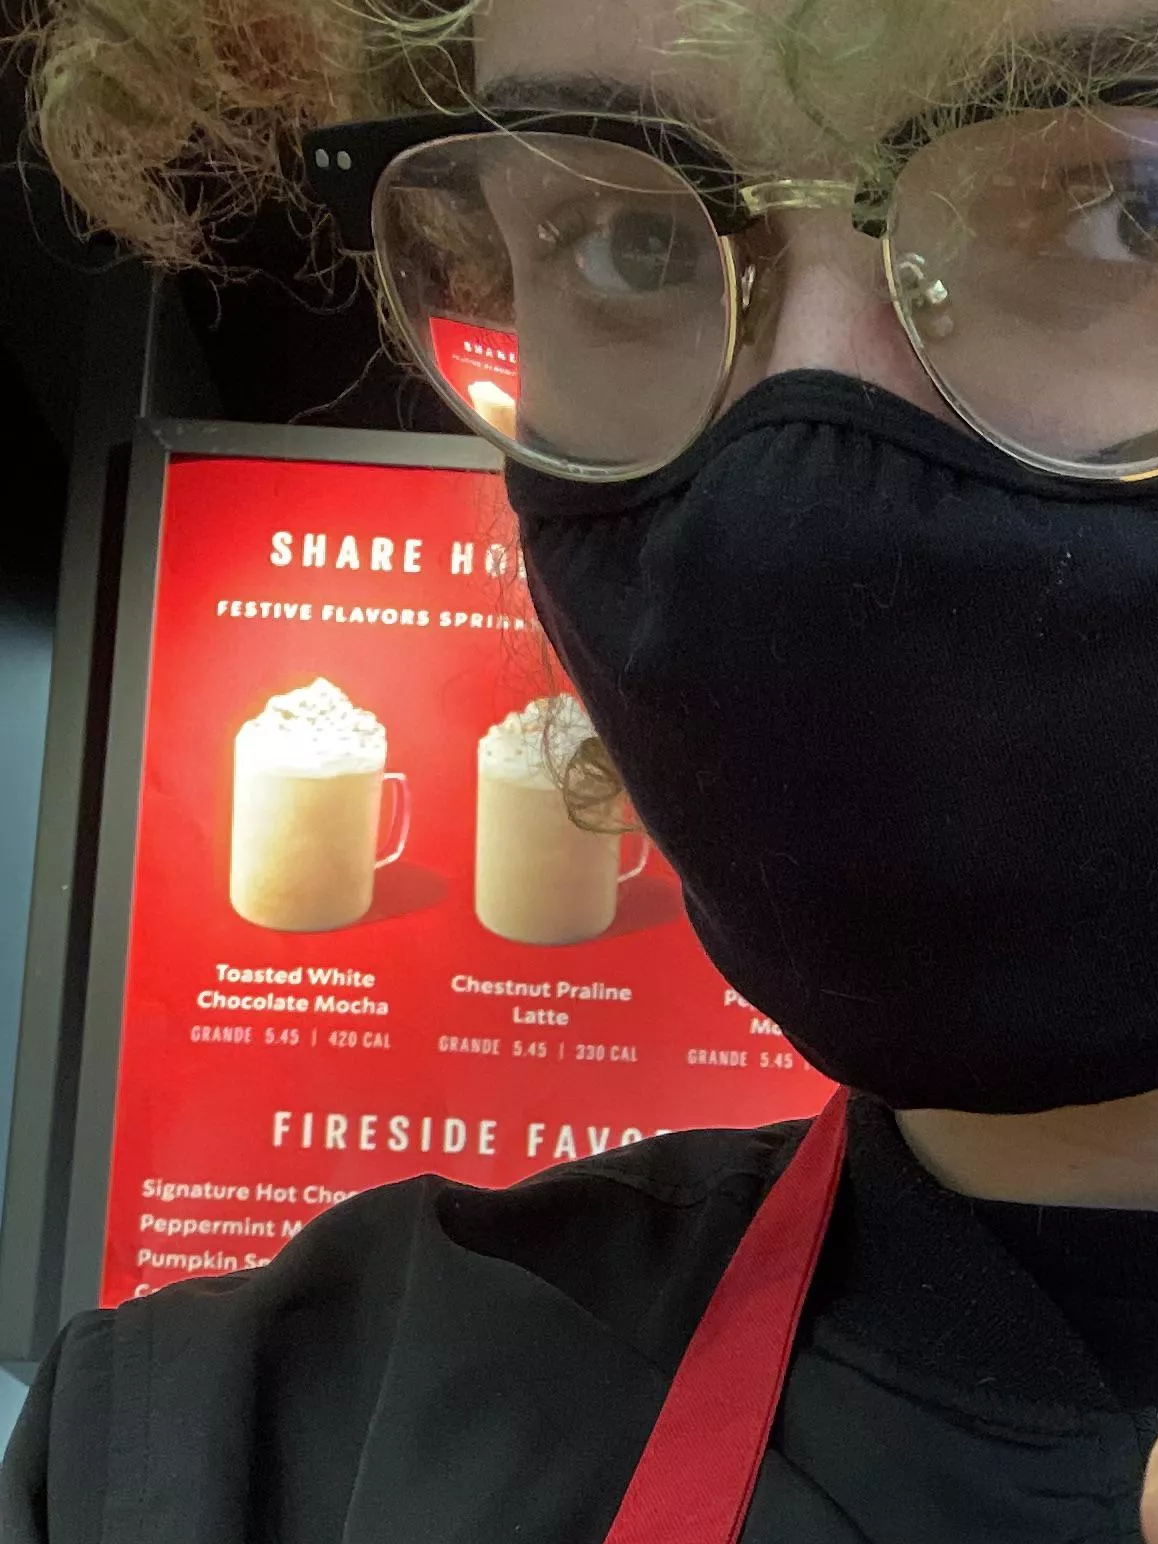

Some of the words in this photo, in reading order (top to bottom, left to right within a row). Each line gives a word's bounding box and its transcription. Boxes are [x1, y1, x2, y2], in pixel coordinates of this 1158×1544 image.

[270, 531, 423, 573] SHARE
[216, 600, 313, 621] FESTIVE
[321, 605, 430, 627] FLAVORS
[216, 964, 302, 985] Toasted
[307, 967, 376, 988] White
[451, 975, 551, 998] Chestnut
[556, 981, 633, 1001] Praline
[197, 990, 309, 1012] Chocolate
[314, 995, 388, 1015] Mocha
[512, 1006, 569, 1025] Latte
[190, 1025, 252, 1043] GRANDE
[264, 1027, 300, 1044] 5.45
[328, 1030, 357, 1047] 420
[362, 1031, 391, 1049] CAL
[438, 1036, 500, 1055] GRANDE
[512, 1040, 547, 1058] 5.45
[576, 1043, 604, 1060] 330
[610, 1045, 638, 1062] CAL
[687, 1049, 747, 1067] GRANDE
[760, 1053, 793, 1069] 5.45
[273, 1111, 497, 1155] FIRESIDE
[527, 1122, 673, 1160] FAV
[142, 1179, 249, 1202] Signature
[256, 1183, 296, 1203] Hot
[140, 1214, 275, 1237] Peppermint
[137, 1248, 237, 1271] Pumpkin
